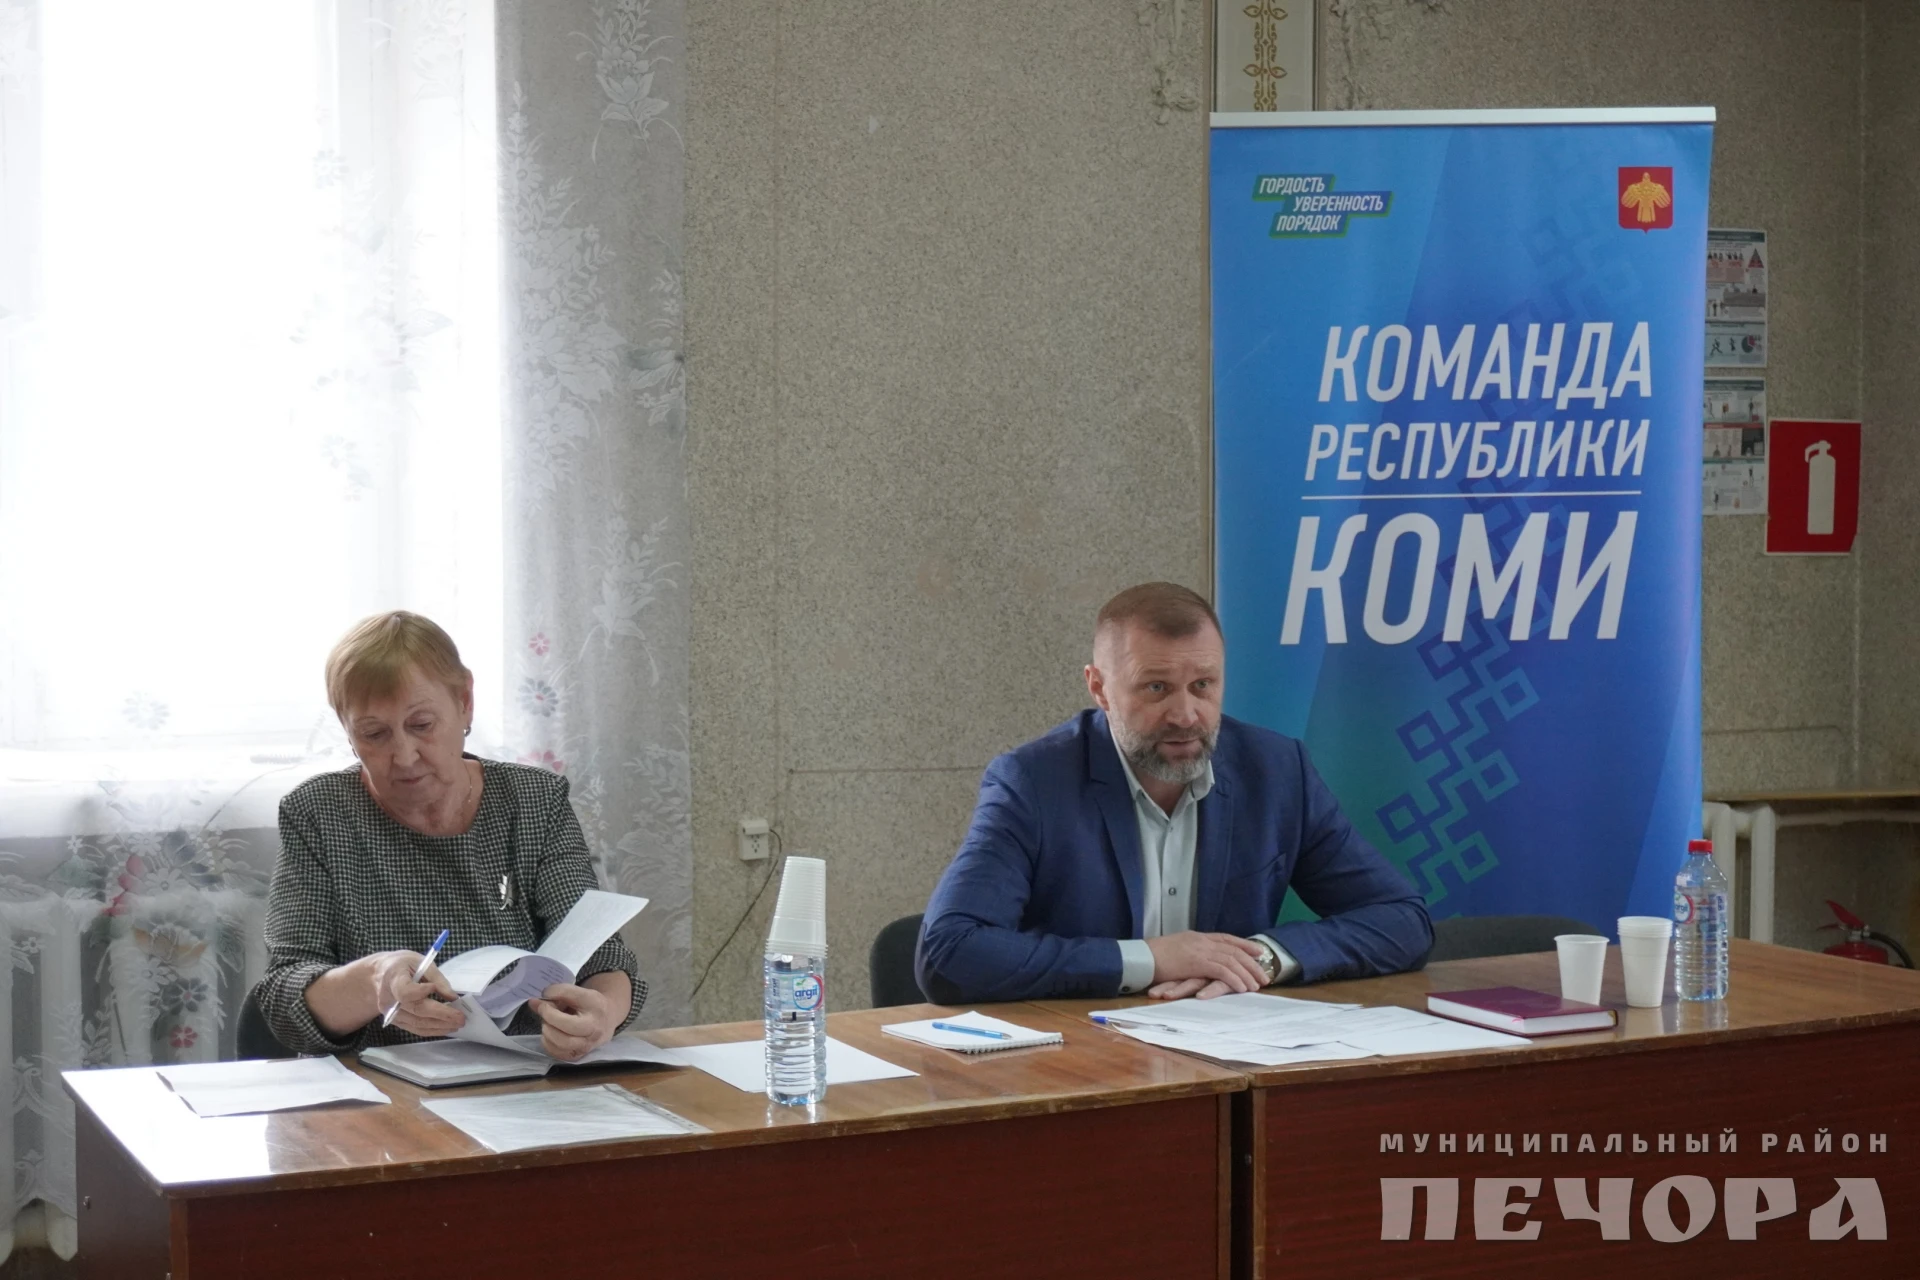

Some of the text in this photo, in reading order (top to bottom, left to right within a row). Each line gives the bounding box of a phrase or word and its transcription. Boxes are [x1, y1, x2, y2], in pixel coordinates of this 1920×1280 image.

[1259, 177, 1325, 195] ГОРДОСТЬ
[1292, 195, 1384, 212] УВЕРЕННОСТЬ
[1276, 214, 1342, 233] ПОРЯДОК
[1318, 322, 1652, 410] КОМАНДА
[1305, 419, 1650, 481] РЕСПУБЛИКИ
[1281, 511, 1638, 645] КОМИ
[794, 984, 818, 1000] argil
